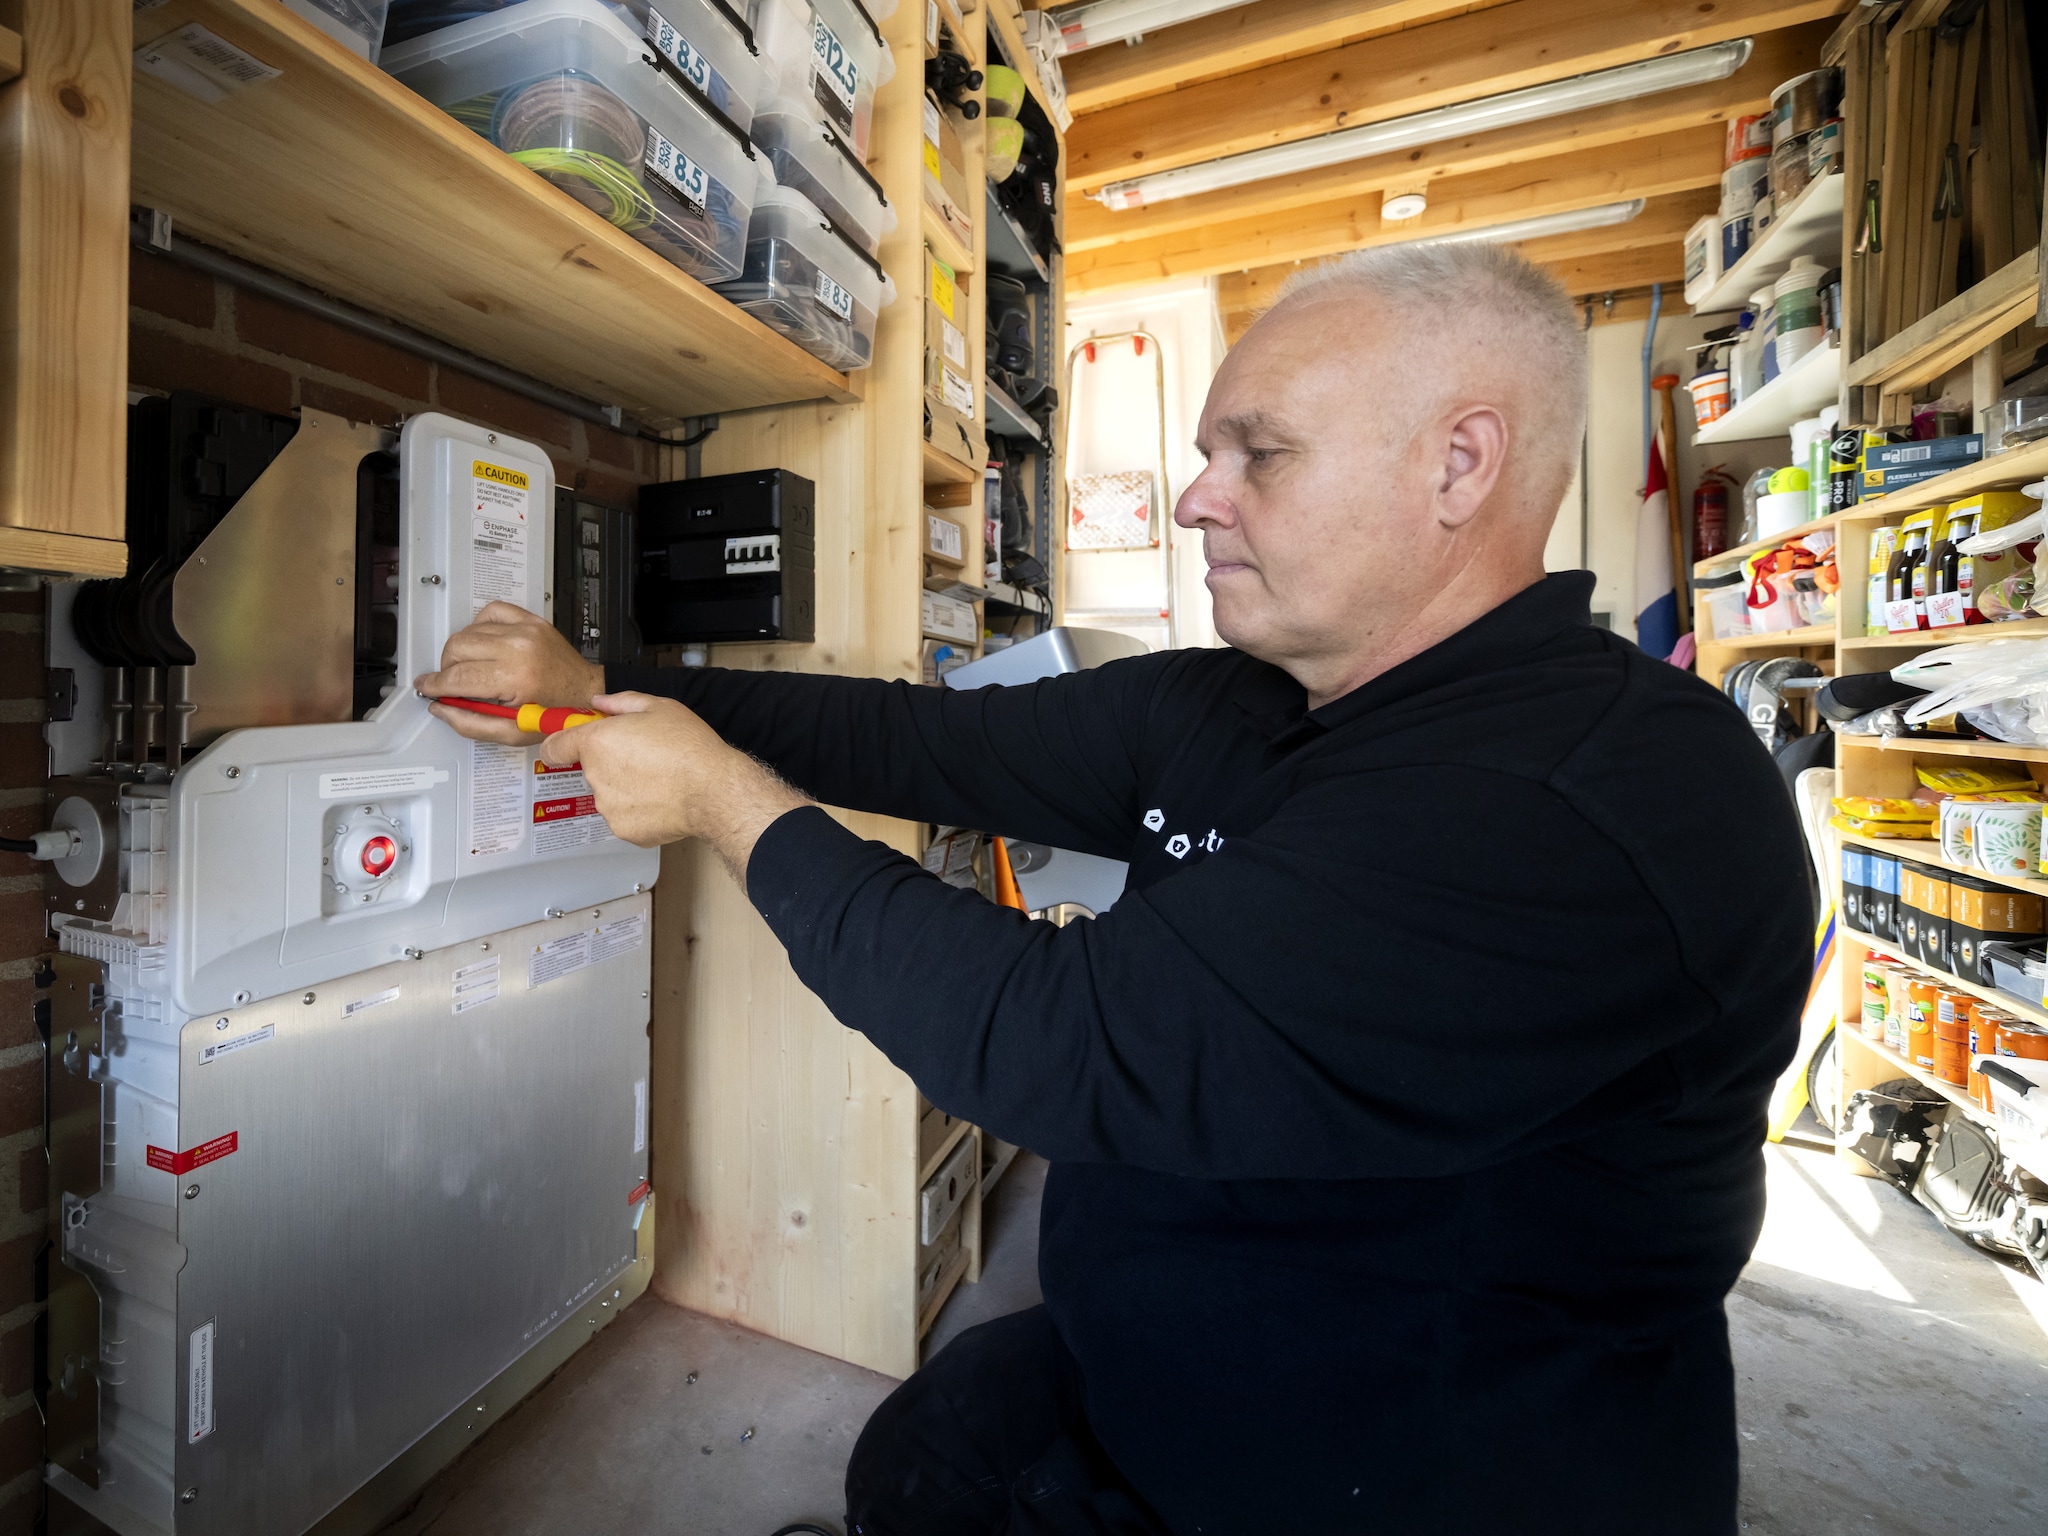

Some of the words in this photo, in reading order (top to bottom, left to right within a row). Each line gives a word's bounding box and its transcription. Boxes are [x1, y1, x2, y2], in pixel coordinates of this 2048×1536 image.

[659, 22, 668, 48] BOX
[665, 26, 674, 54] ONE
[677, 40, 704, 84] 8.5
[826, 32, 856, 95] 12.5
[658, 138, 666, 165] BOX
[663, 140, 672, 169] ONE
[675, 154, 702, 194] 8.5
[833, 285, 848, 312] 8.5
[485, 467, 526, 486] CAUTION
[1887, 472, 1917, 481] FLEXIBLE
[1833, 481, 1844, 504] PRO
[491, 524, 518, 534] ENPHASE
[546, 804, 570, 813] CAUTION!
[203, 1135, 232, 1151] WARNING!
